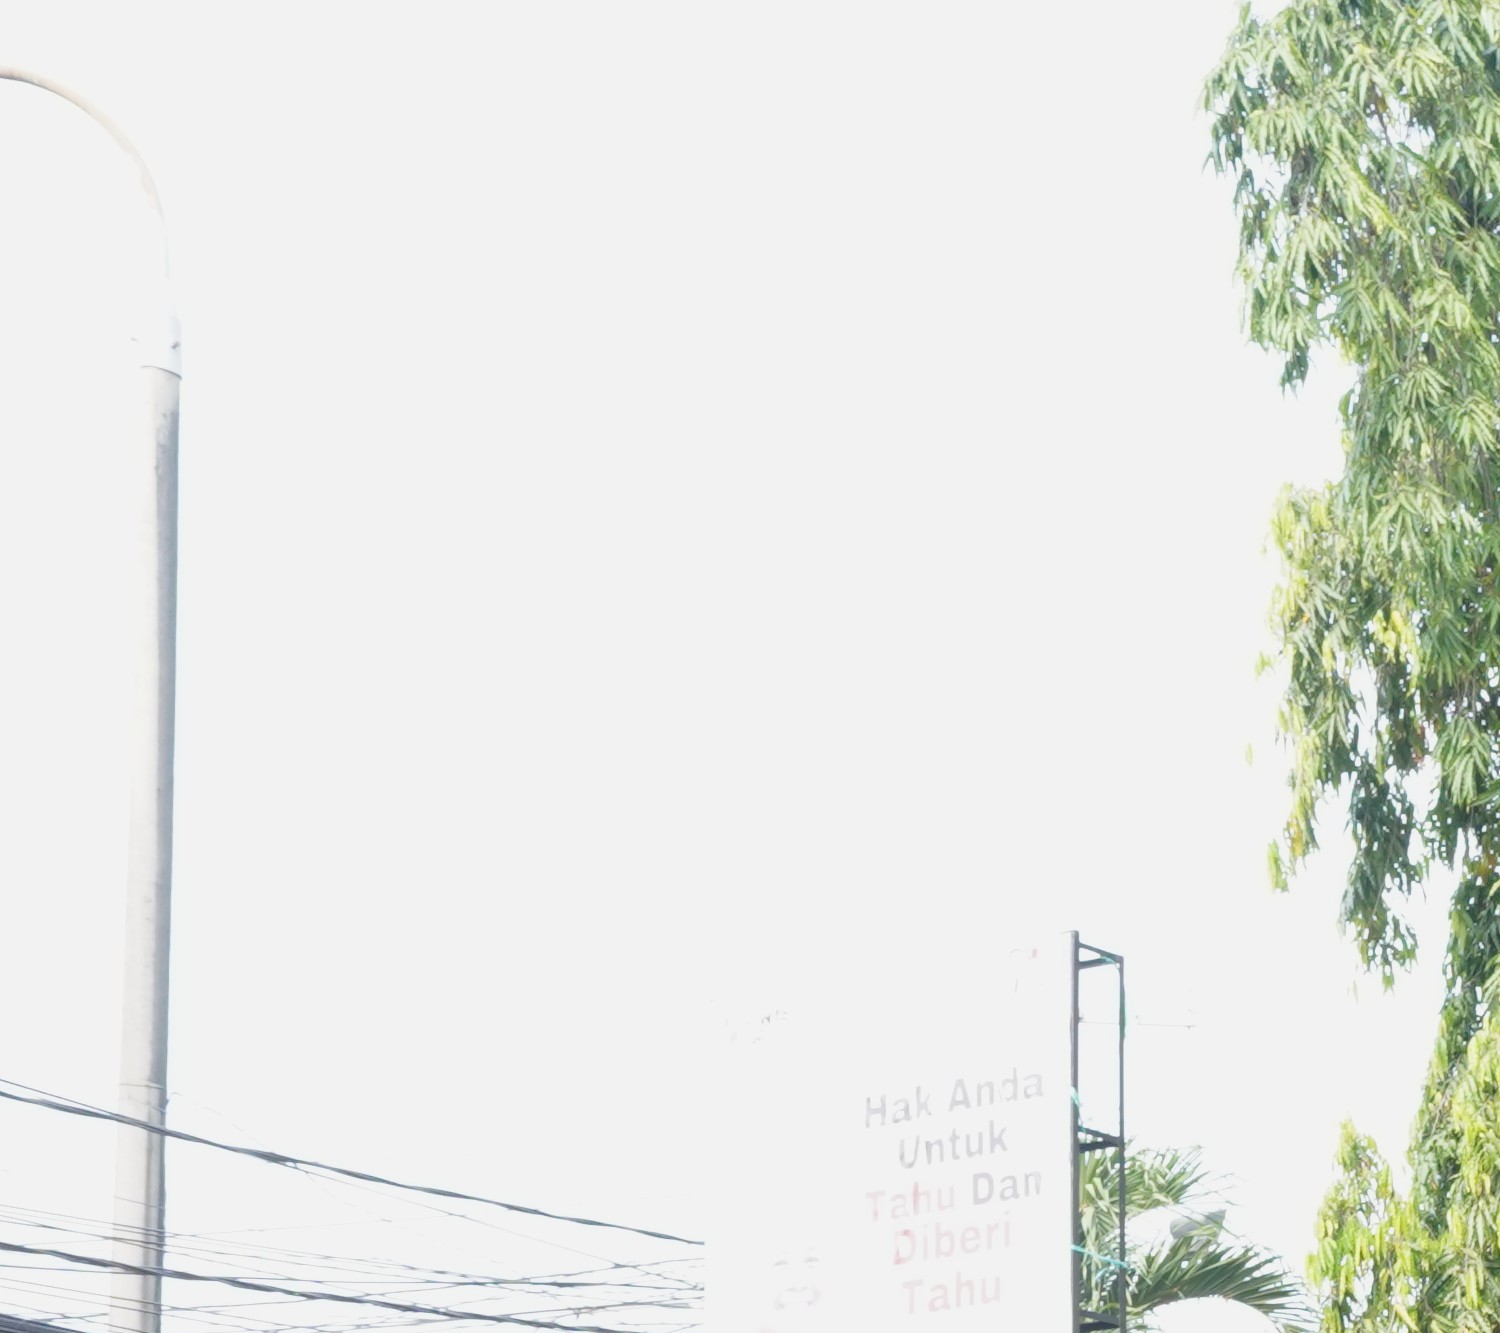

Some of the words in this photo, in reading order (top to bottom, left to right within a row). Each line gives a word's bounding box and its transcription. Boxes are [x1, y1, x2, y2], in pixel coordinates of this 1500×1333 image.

[865, 1085, 932, 1128] Hak
[949, 1067, 1044, 1112] Anda
[898, 1120, 1008, 1169] Untuk
[864, 1181, 955, 1223] Tahu
[972, 1170, 1041, 1206] Dan
[892, 1210, 1011, 1265] Diberi
[901, 1271, 1001, 1315] Tahu
